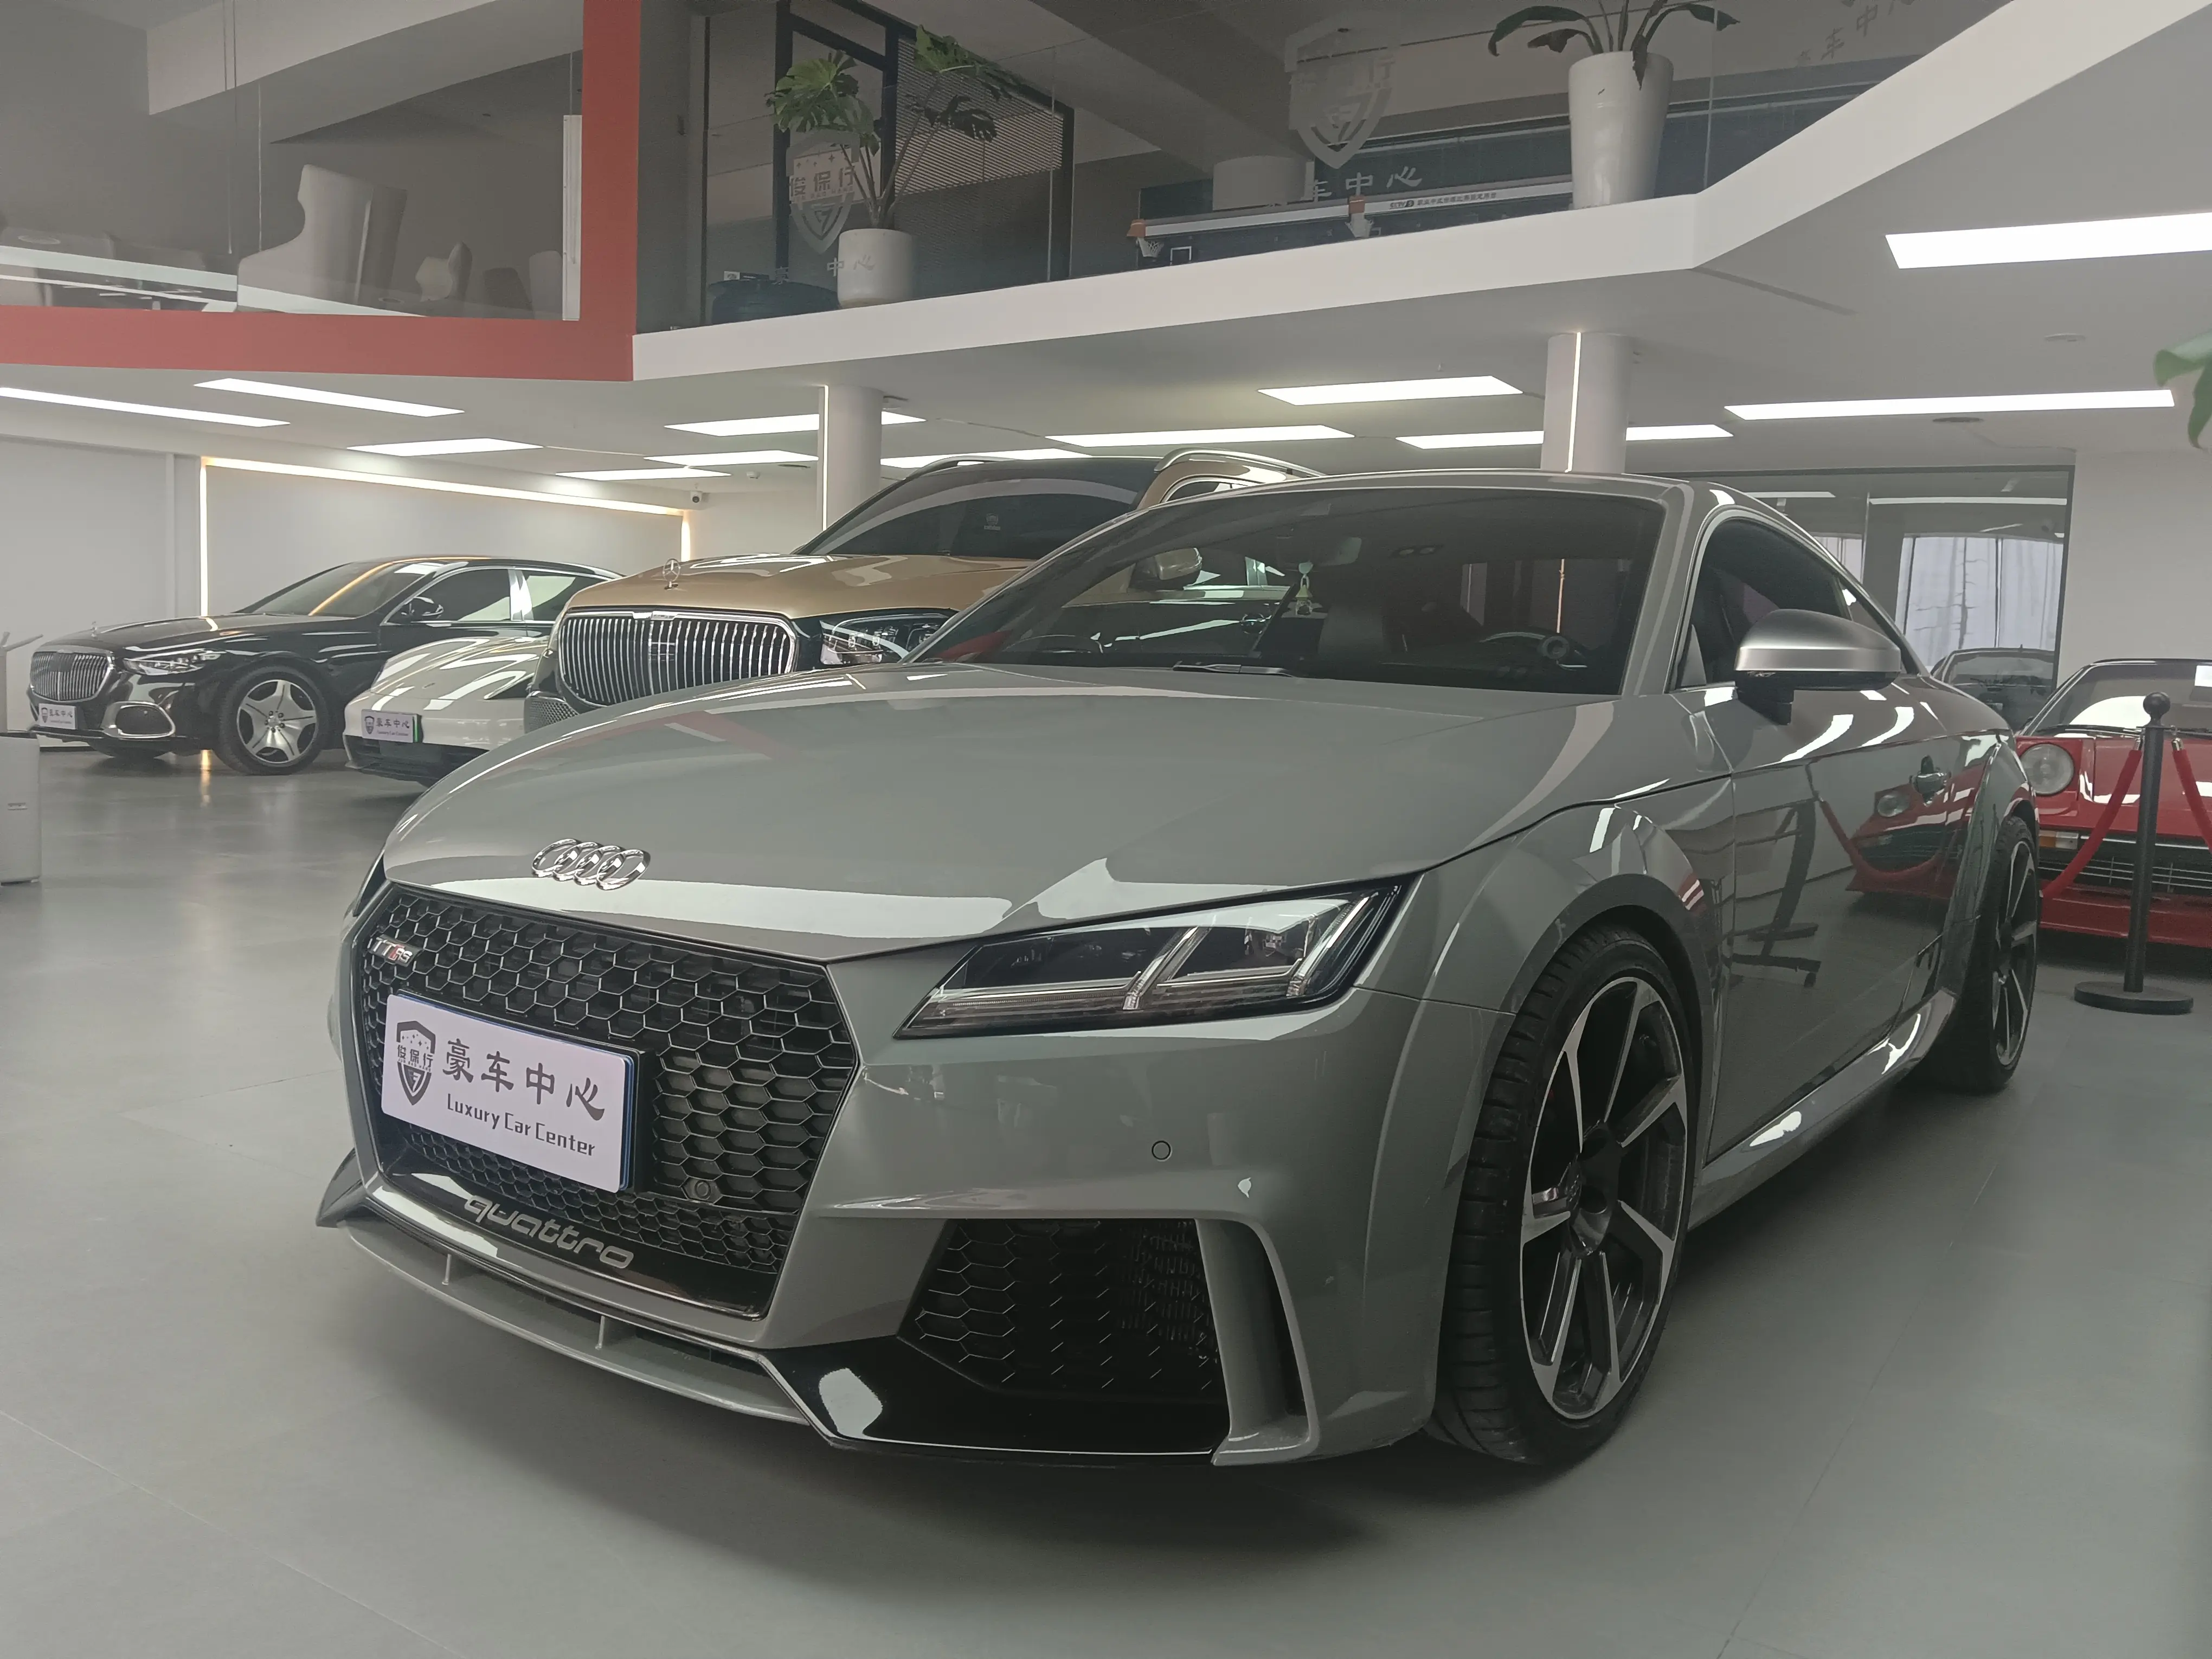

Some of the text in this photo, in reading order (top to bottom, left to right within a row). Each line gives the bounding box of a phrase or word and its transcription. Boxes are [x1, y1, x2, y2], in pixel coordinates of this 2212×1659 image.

[442, 1038, 605, 1121] 豪车中心
[447, 1093, 595, 1156] Luxury Car Center
[464, 1195, 634, 1269] quattro
